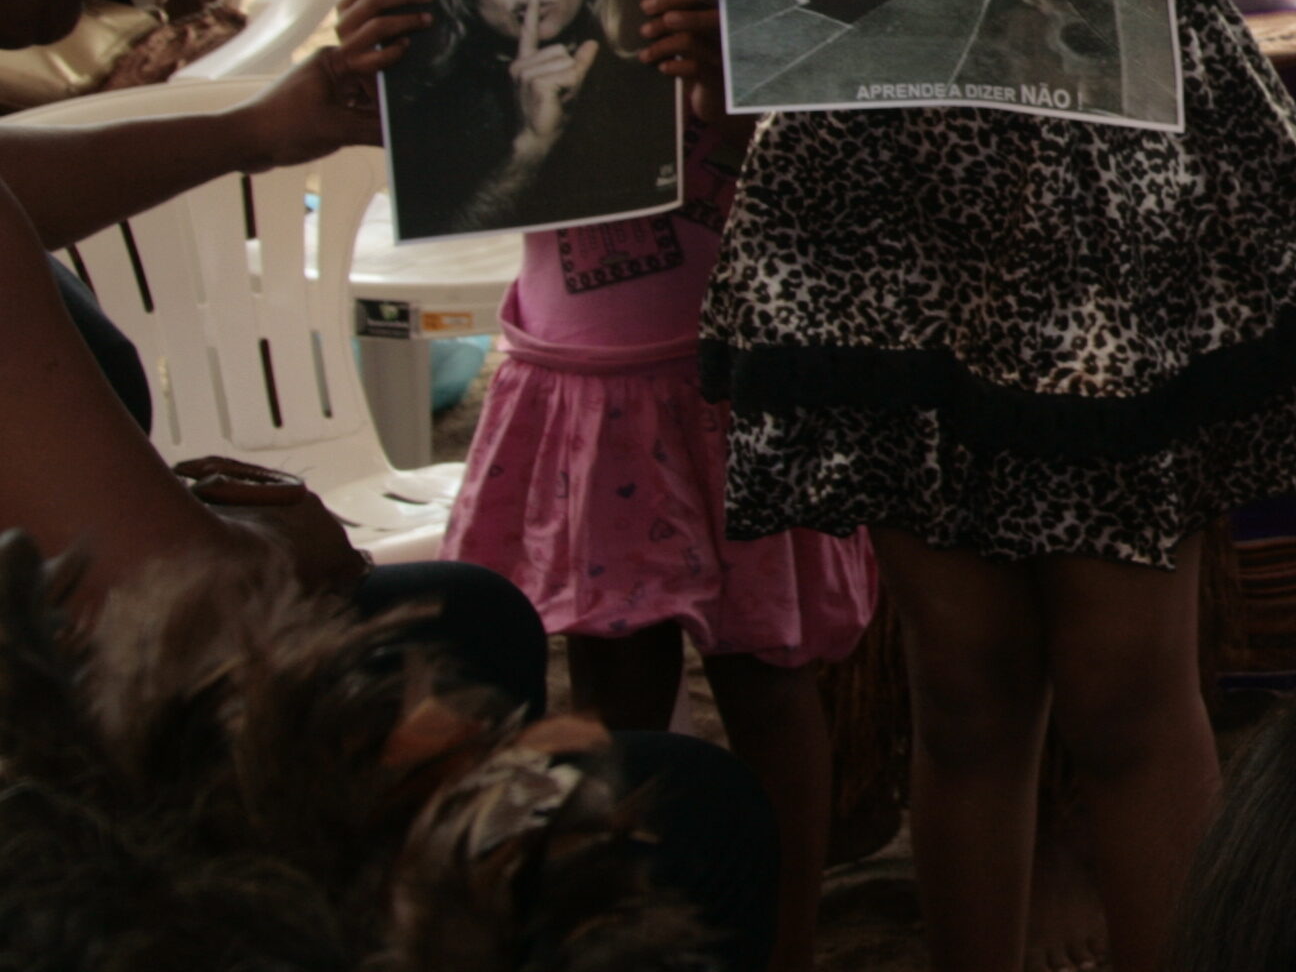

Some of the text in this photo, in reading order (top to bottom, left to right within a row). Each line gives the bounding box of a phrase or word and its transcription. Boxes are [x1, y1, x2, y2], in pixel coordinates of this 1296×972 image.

[856, 82, 947, 101] APRENDE
[949, 83, 962, 99] A
[965, 83, 1016, 103] DIZER
[1020, 81, 1071, 110] NÃO
